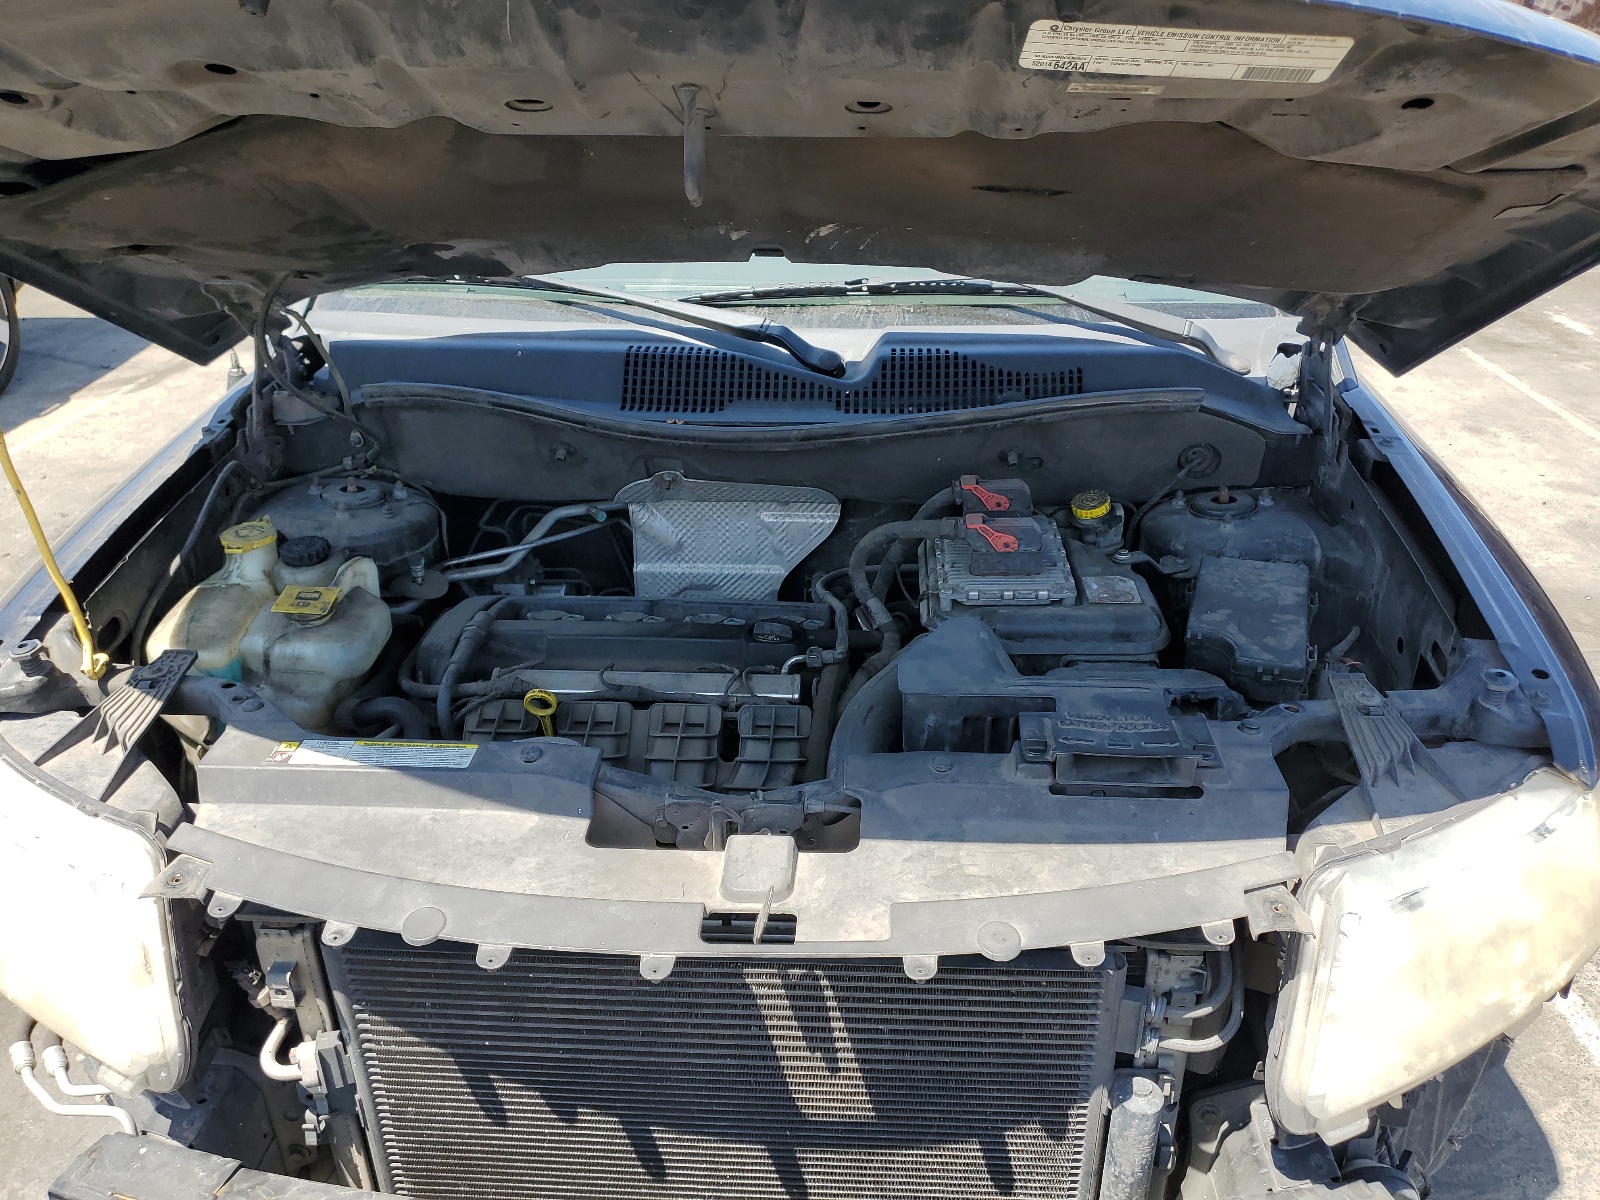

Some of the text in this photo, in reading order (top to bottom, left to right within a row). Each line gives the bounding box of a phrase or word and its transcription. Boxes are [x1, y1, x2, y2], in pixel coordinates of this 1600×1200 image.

[1064, 25, 1093, 34] Chrysler
[1094, 27, 1116, 35] Group
[1053, 61, 1085, 71] 642AA
[1117, 723, 1169, 731] ACCESS
